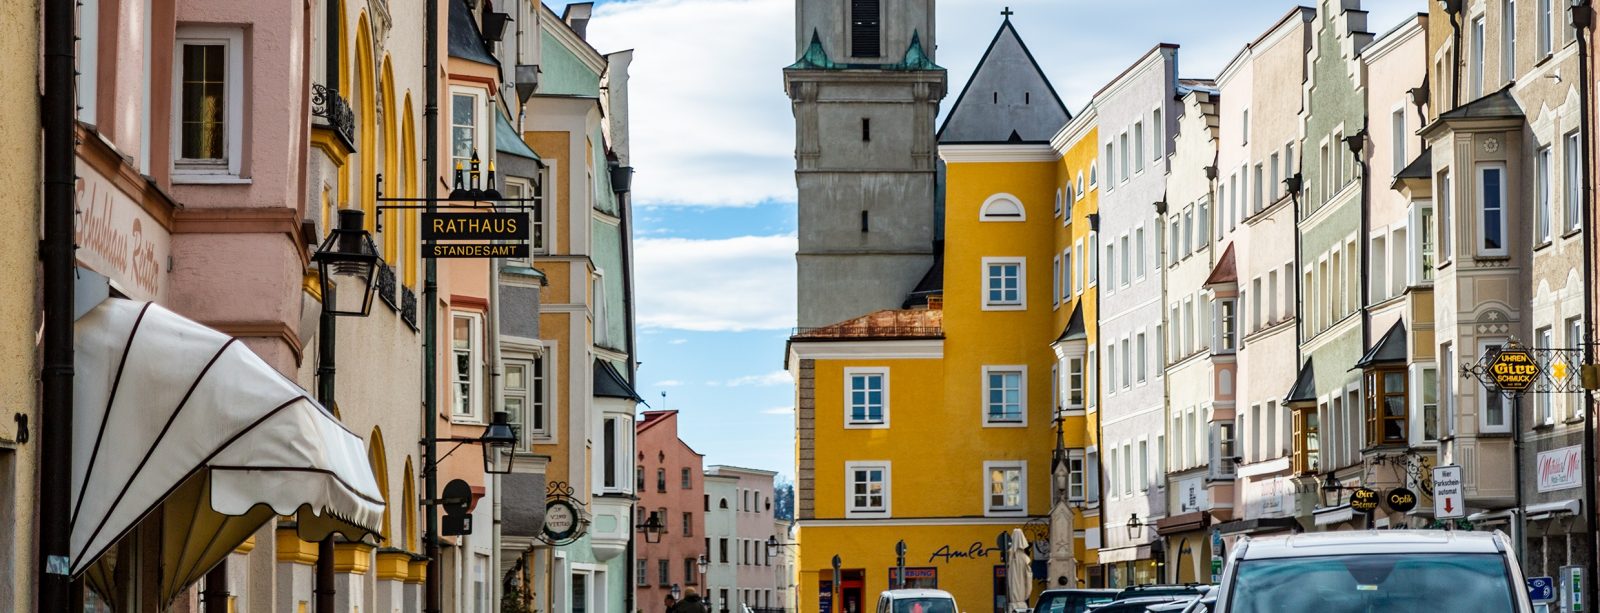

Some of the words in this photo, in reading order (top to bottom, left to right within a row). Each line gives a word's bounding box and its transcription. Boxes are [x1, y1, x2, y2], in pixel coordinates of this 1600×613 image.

[433, 218, 517, 234] RATHAUS
[434, 245, 517, 256] STANDESAMT
[1391, 494, 1413, 505] Optik
